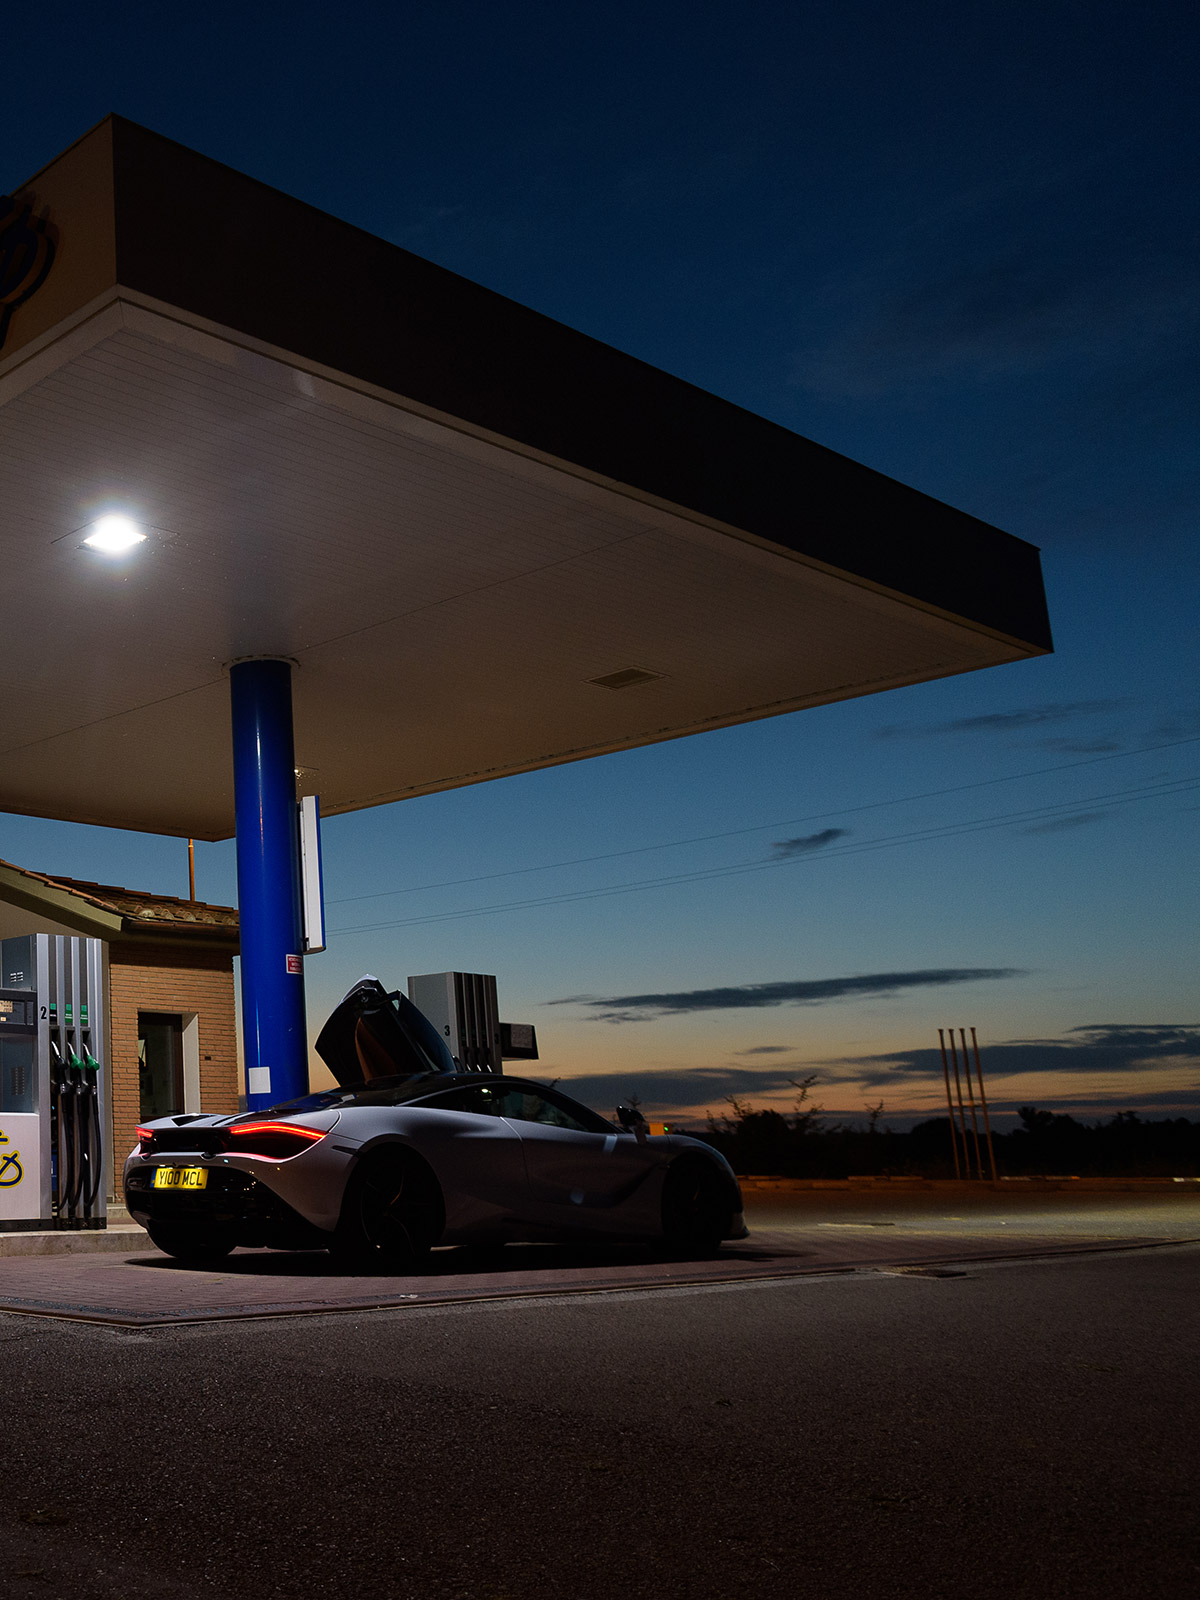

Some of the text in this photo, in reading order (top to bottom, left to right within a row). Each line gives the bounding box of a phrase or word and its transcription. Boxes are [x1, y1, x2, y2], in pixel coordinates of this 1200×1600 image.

[40, 1006, 47, 1020] 2
[444, 1025, 451, 1037] 3
[181, 1171, 203, 1186] MCL
